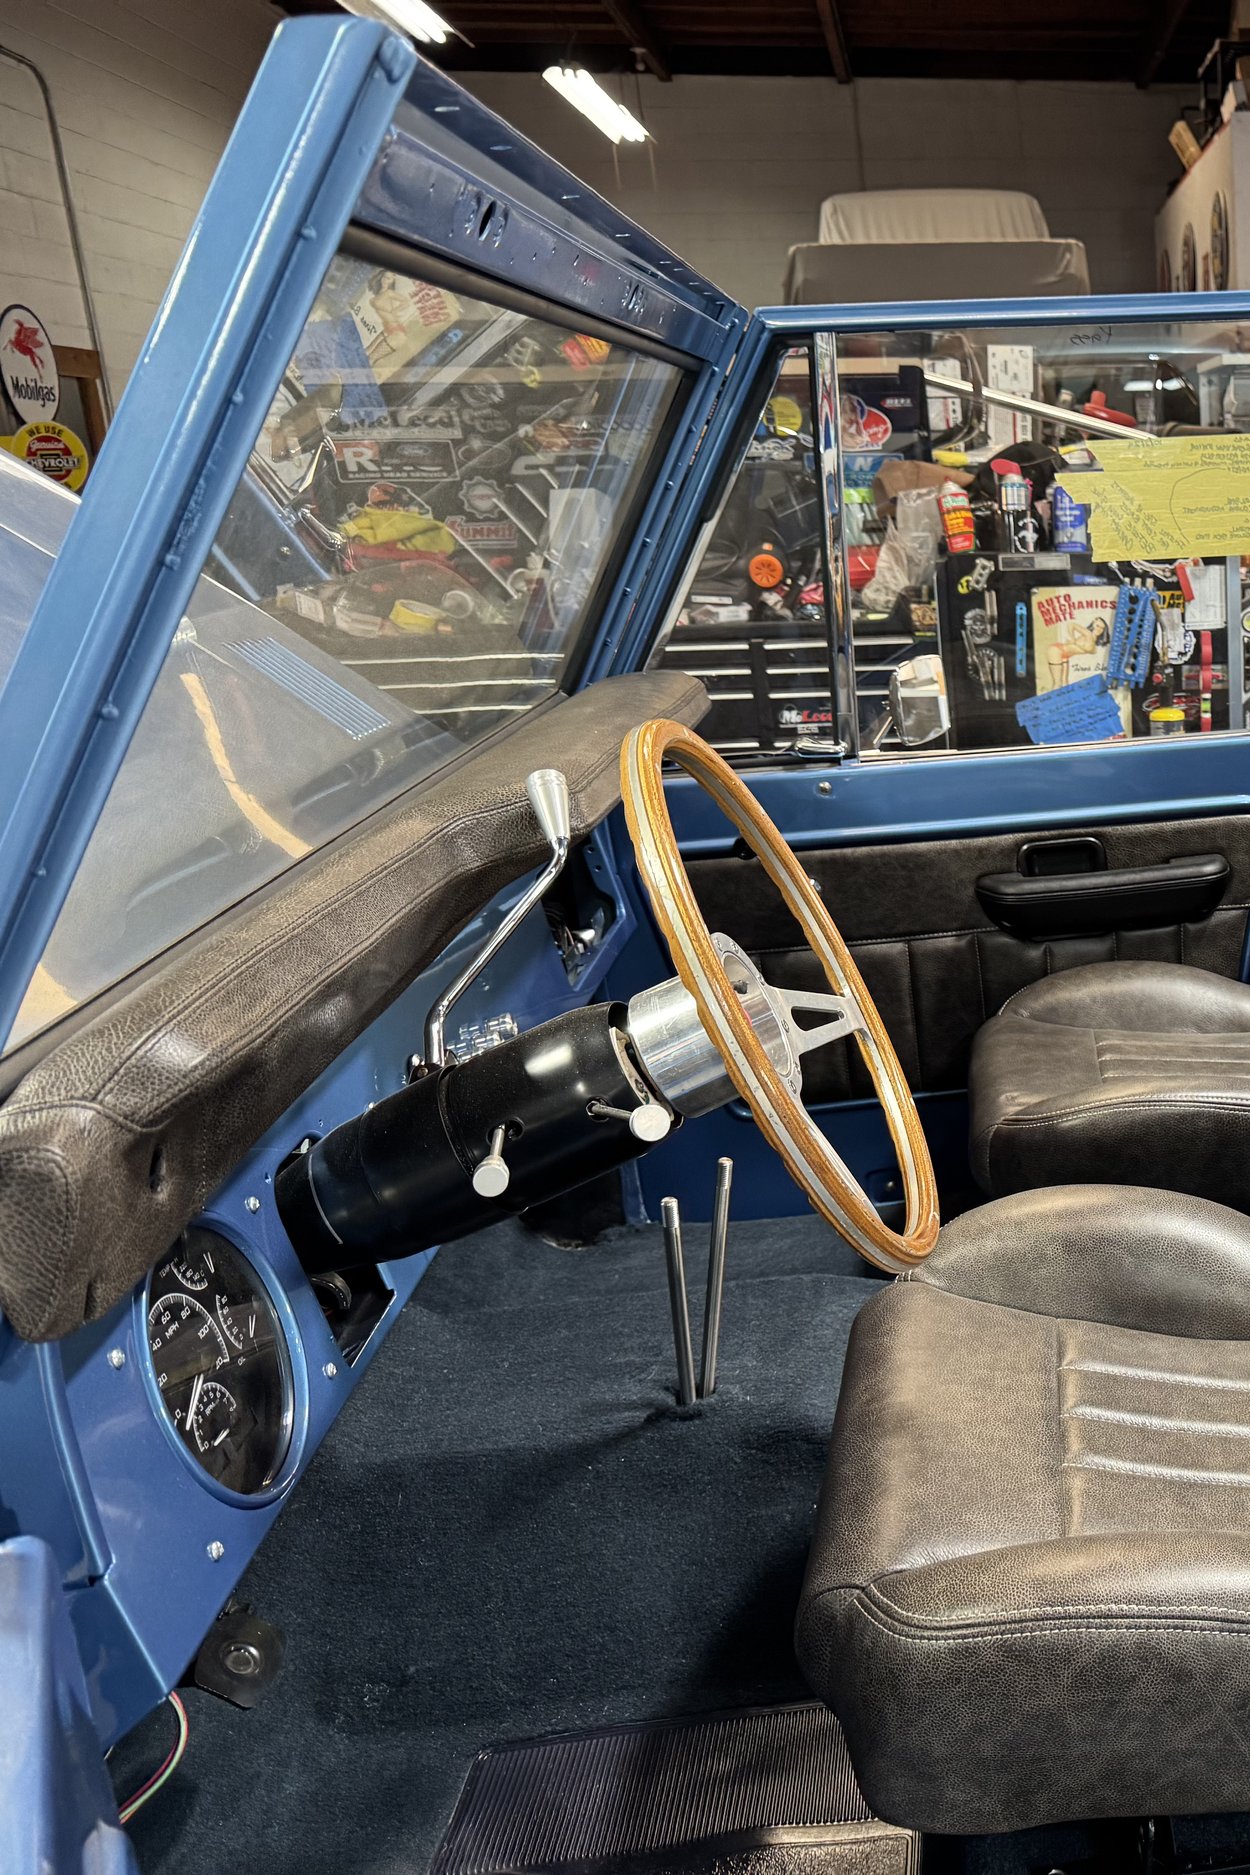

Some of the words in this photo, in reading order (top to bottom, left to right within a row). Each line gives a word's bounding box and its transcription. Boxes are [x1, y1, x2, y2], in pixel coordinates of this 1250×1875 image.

[10, 375, 56, 408] Mobilgas
[26, 426, 42, 437] WE
[44, 425, 64, 437] USE
[1037, 593, 1071, 610] AUTO
[1041, 600, 1117, 620] MECHANICS
[1045, 610, 1075, 627] MATE
[161, 1311, 171, 1325] 60
[180, 1306, 191, 1320] 80
[165, 1320, 179, 1340] MPH
[197, 1324, 209, 1340] 100
[152, 1337, 162, 1352] 40
[157, 1372, 168, 1388] 20
